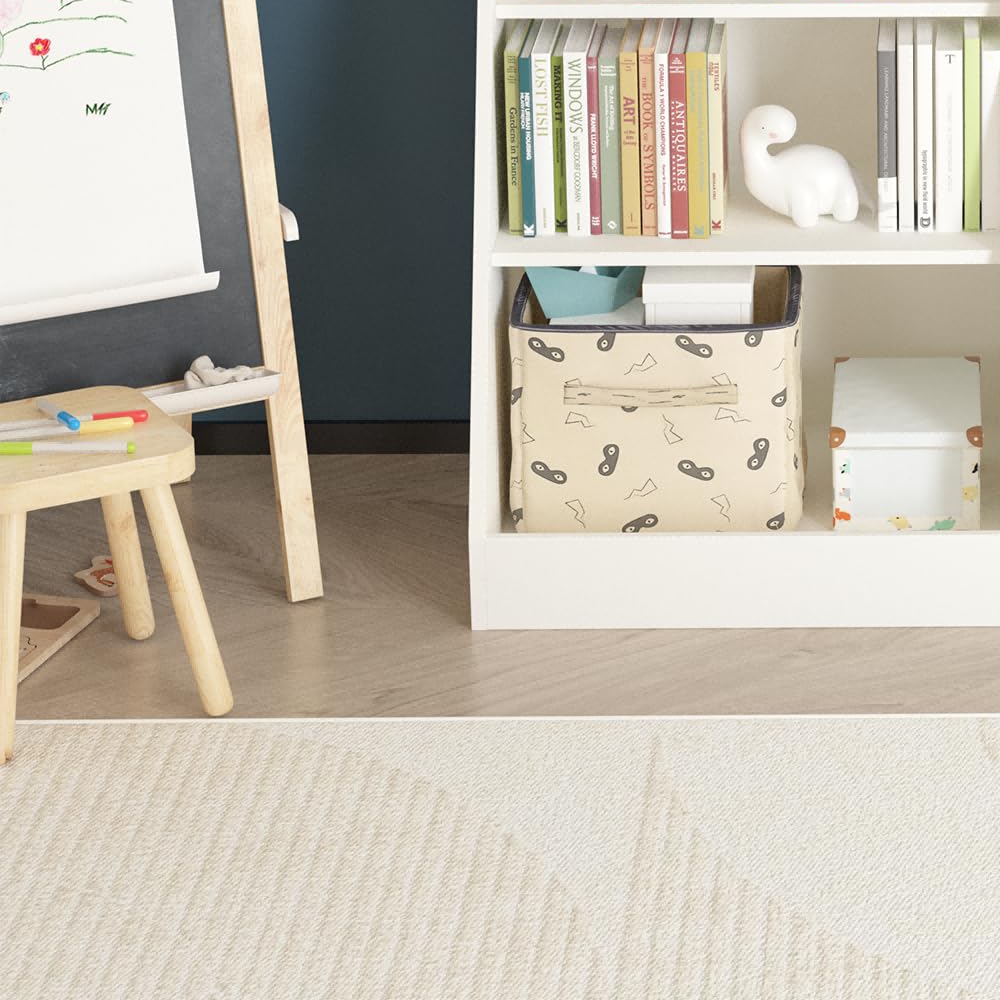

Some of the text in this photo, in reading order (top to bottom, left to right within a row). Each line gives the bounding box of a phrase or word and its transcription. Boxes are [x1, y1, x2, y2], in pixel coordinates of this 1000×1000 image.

[945, 55, 955, 64] T
[534, 59, 548, 136] LOST FISH
[554, 65, 562, 108] MAKING
[568, 58, 583, 134] WINDOWS
[555, 112, 562, 123] IT
[623, 97, 635, 126] ART
[642, 92, 654, 130] BOOK
[510, 144, 518, 154] in
[675, 100, 686, 191] ANTIQUAIRES
[642, 144, 656, 210] SYMBOLS
[920, 216, 931, 228] D
